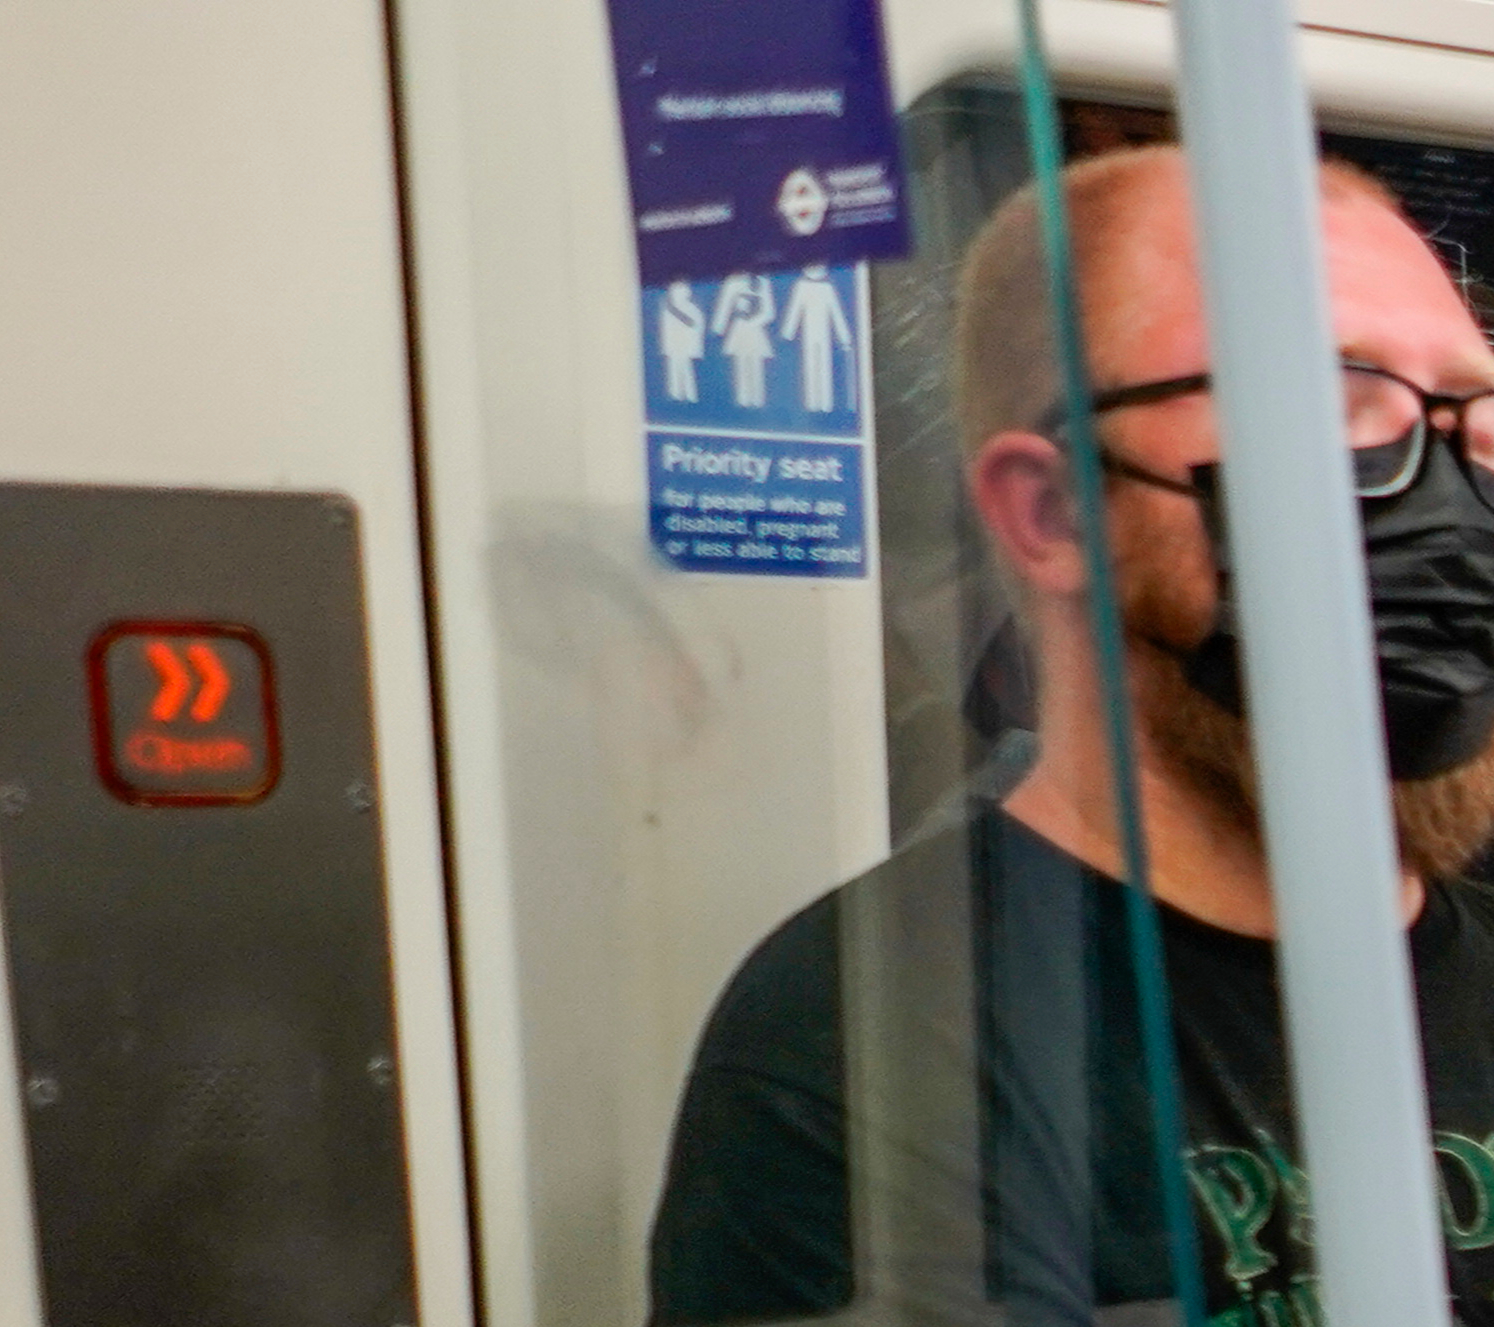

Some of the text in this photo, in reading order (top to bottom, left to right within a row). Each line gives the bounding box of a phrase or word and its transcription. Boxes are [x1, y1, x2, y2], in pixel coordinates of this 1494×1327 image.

[662, 442, 844, 484] Priority seat
[696, 493, 767, 515] people
[755, 520, 840, 542] pregnant
[125, 731, 253, 775] Open
